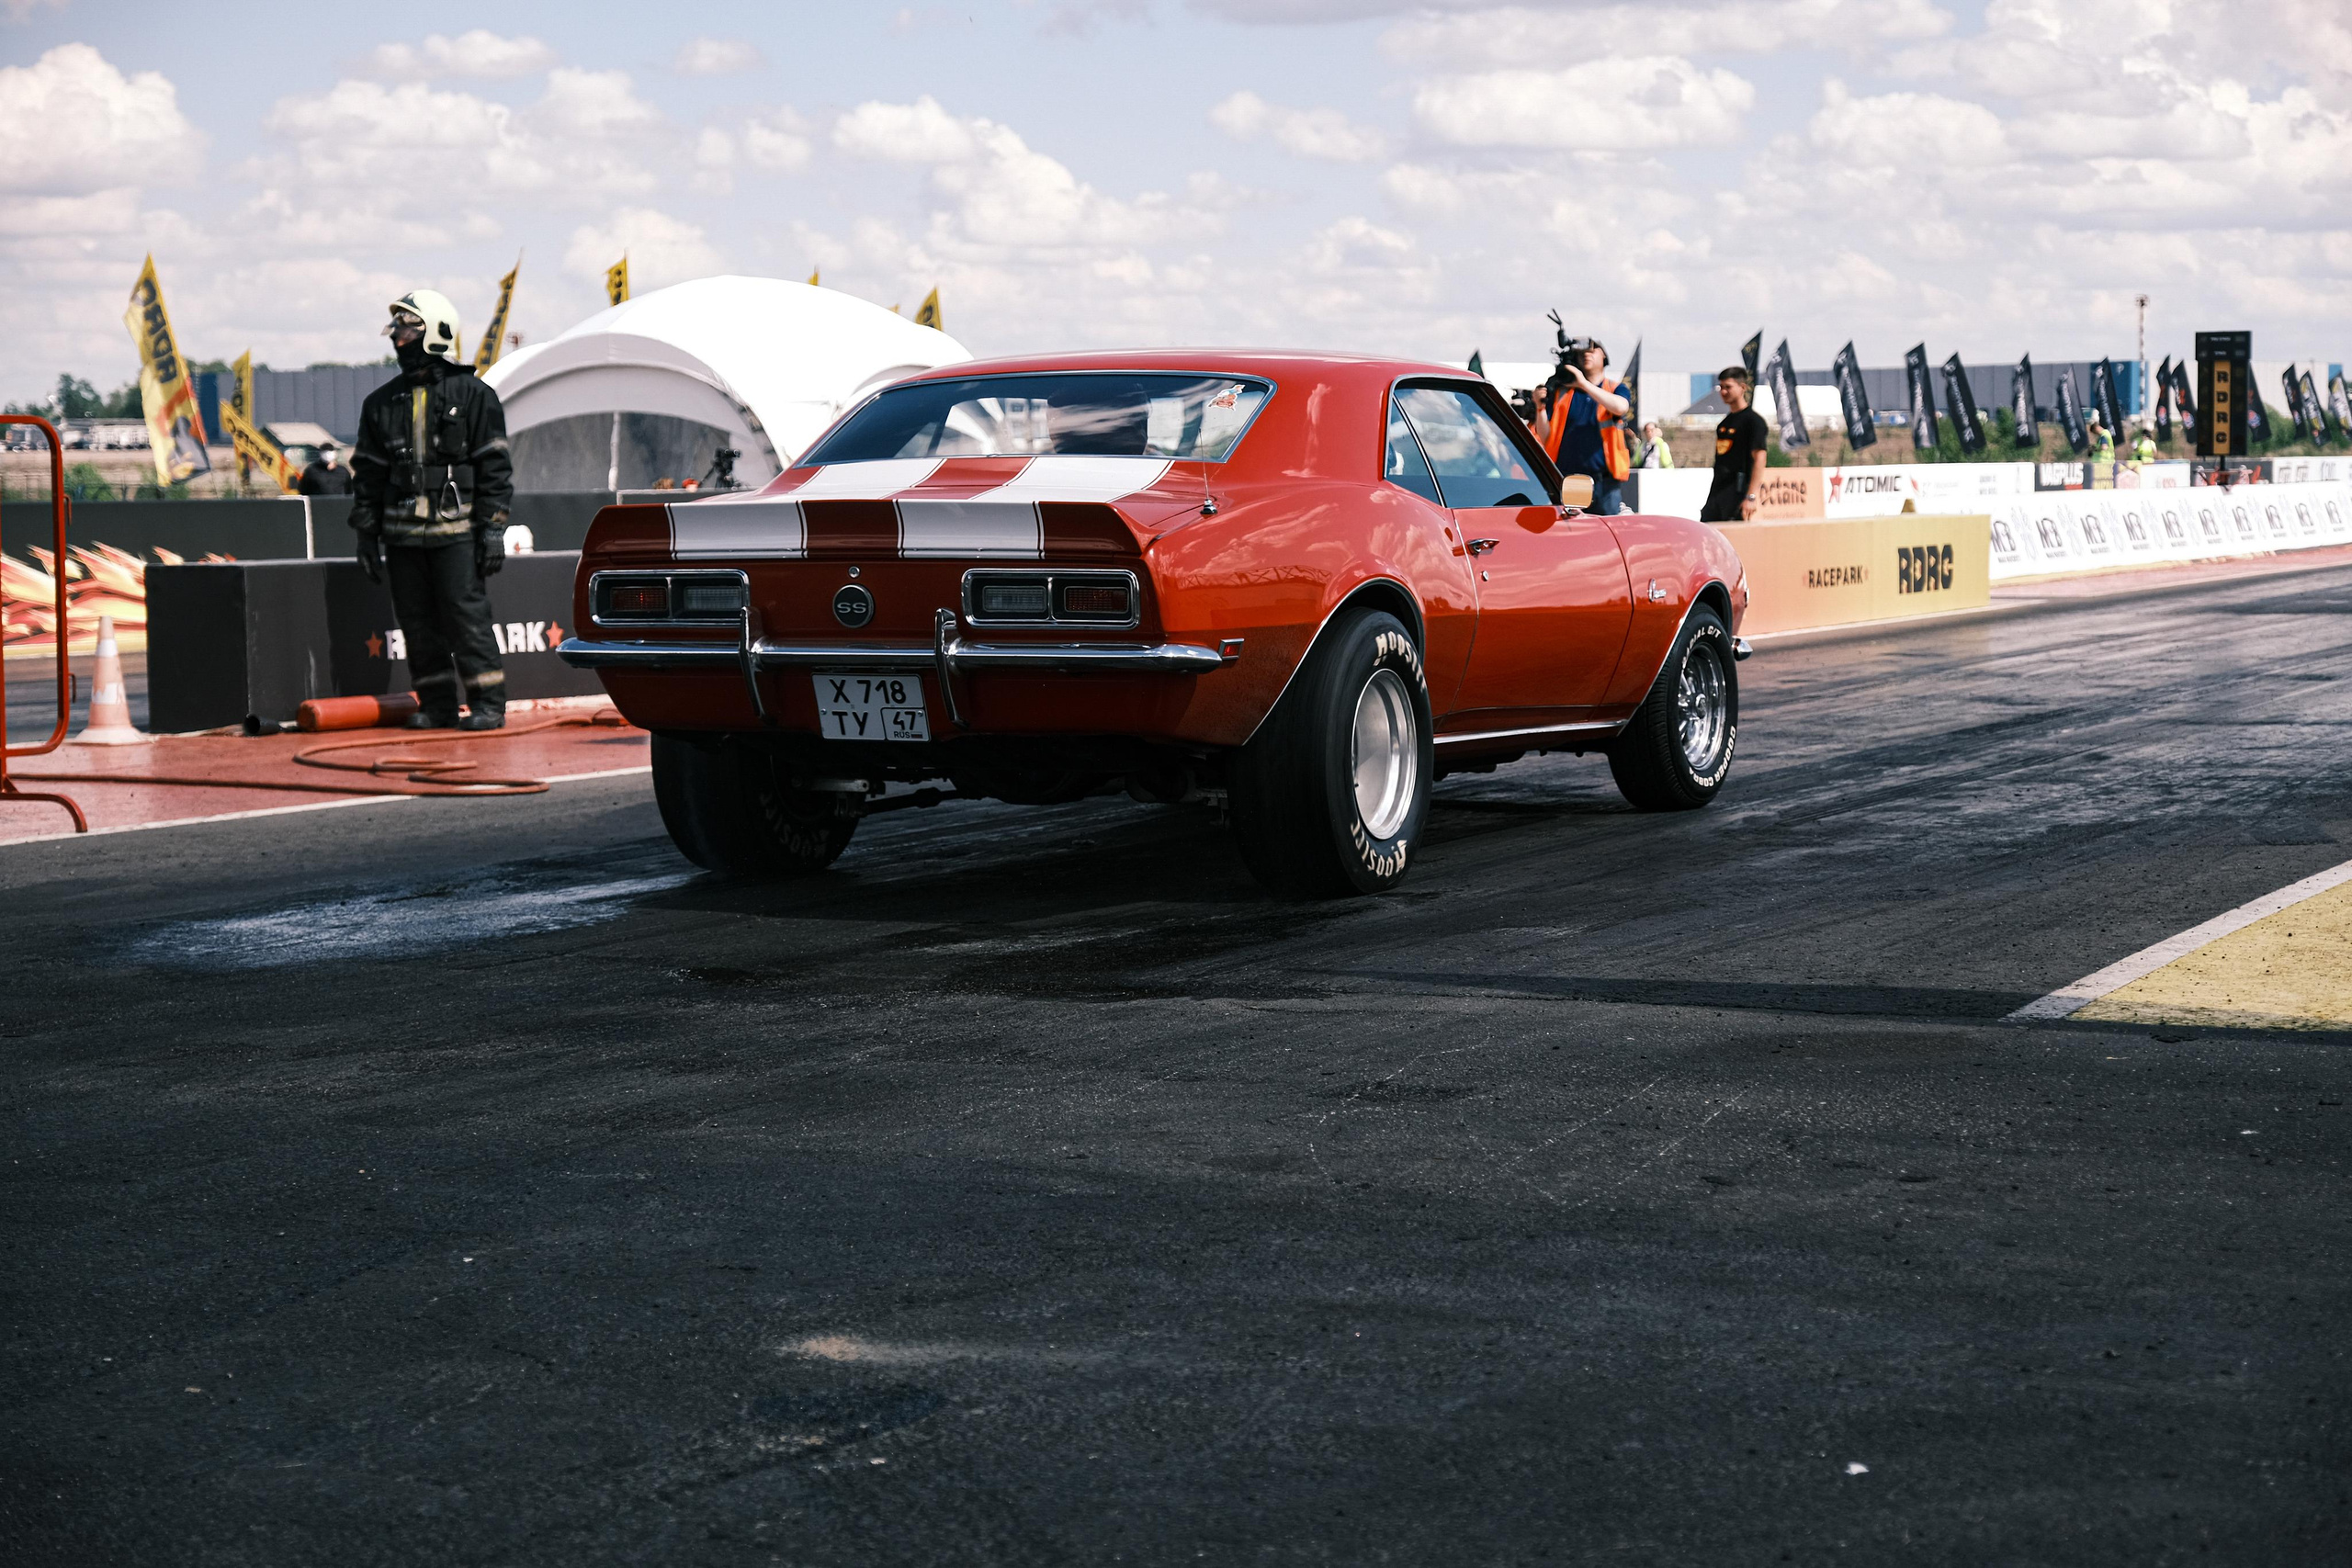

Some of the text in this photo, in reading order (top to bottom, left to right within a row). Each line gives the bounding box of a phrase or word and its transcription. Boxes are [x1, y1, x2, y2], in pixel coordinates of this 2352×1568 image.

[1844, 475, 1903, 494] ATOMIC
[1808, 565, 1864, 589] RACEPARK
[1897, 544, 1954, 594] RDRC
[837, 602, 867, 614] SS
[1707, 625, 1722, 638] G/T
[829, 679, 907, 705] X 718
[831, 710, 869, 736] TY
[892, 711, 917, 731] 47
[1689, 725, 1736, 787] COOPER COBRA
